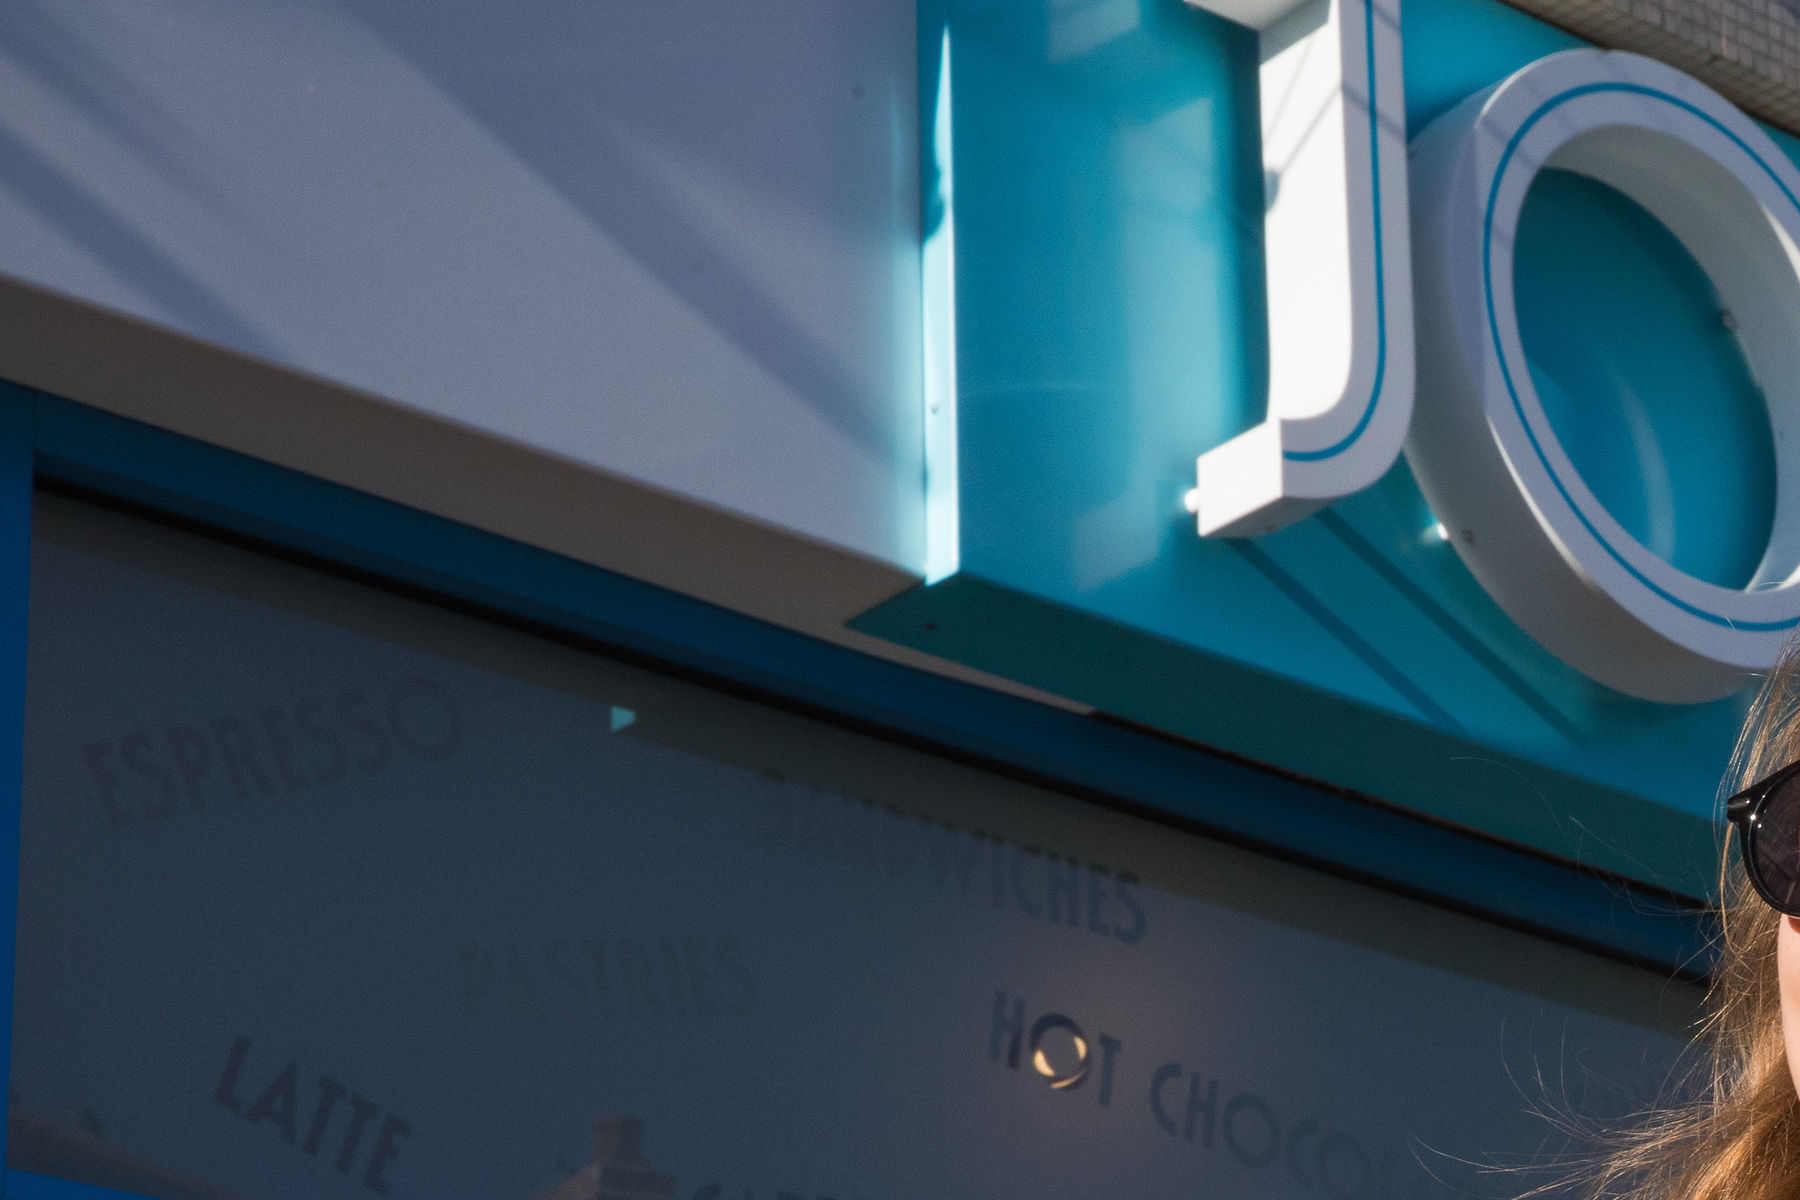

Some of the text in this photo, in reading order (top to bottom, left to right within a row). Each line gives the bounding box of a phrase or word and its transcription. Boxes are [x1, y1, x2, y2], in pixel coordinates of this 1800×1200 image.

[82, 678, 463, 828] ESPRESSO
[213, 1035, 411, 1198] LATTE
[989, 989, 1121, 1107] HOT
